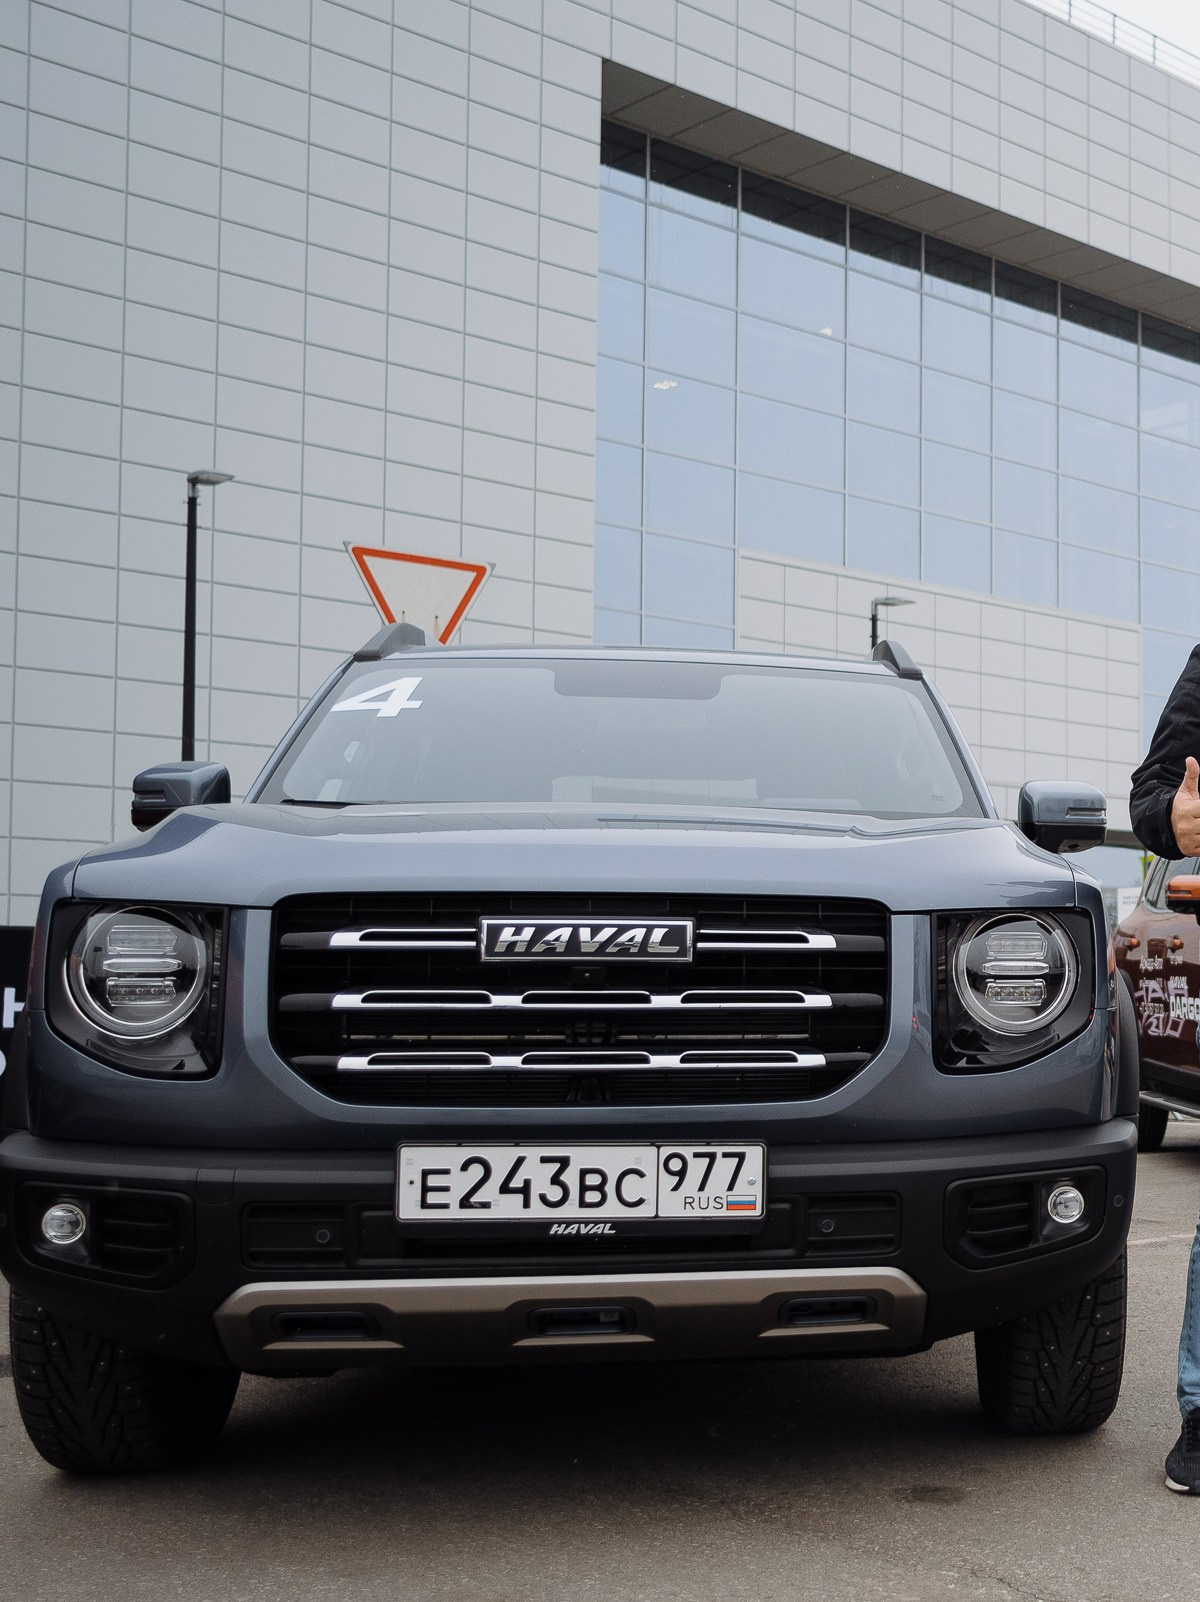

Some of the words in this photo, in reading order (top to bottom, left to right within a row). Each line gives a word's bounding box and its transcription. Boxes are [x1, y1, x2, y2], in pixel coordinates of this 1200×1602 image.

[330, 676, 423, 718] 4
[494, 926, 680, 953] HAVAL
[662, 1151, 747, 1192] 977
[683, 1196, 724, 1211] RUS
[549, 1223, 617, 1236] HAVAL
